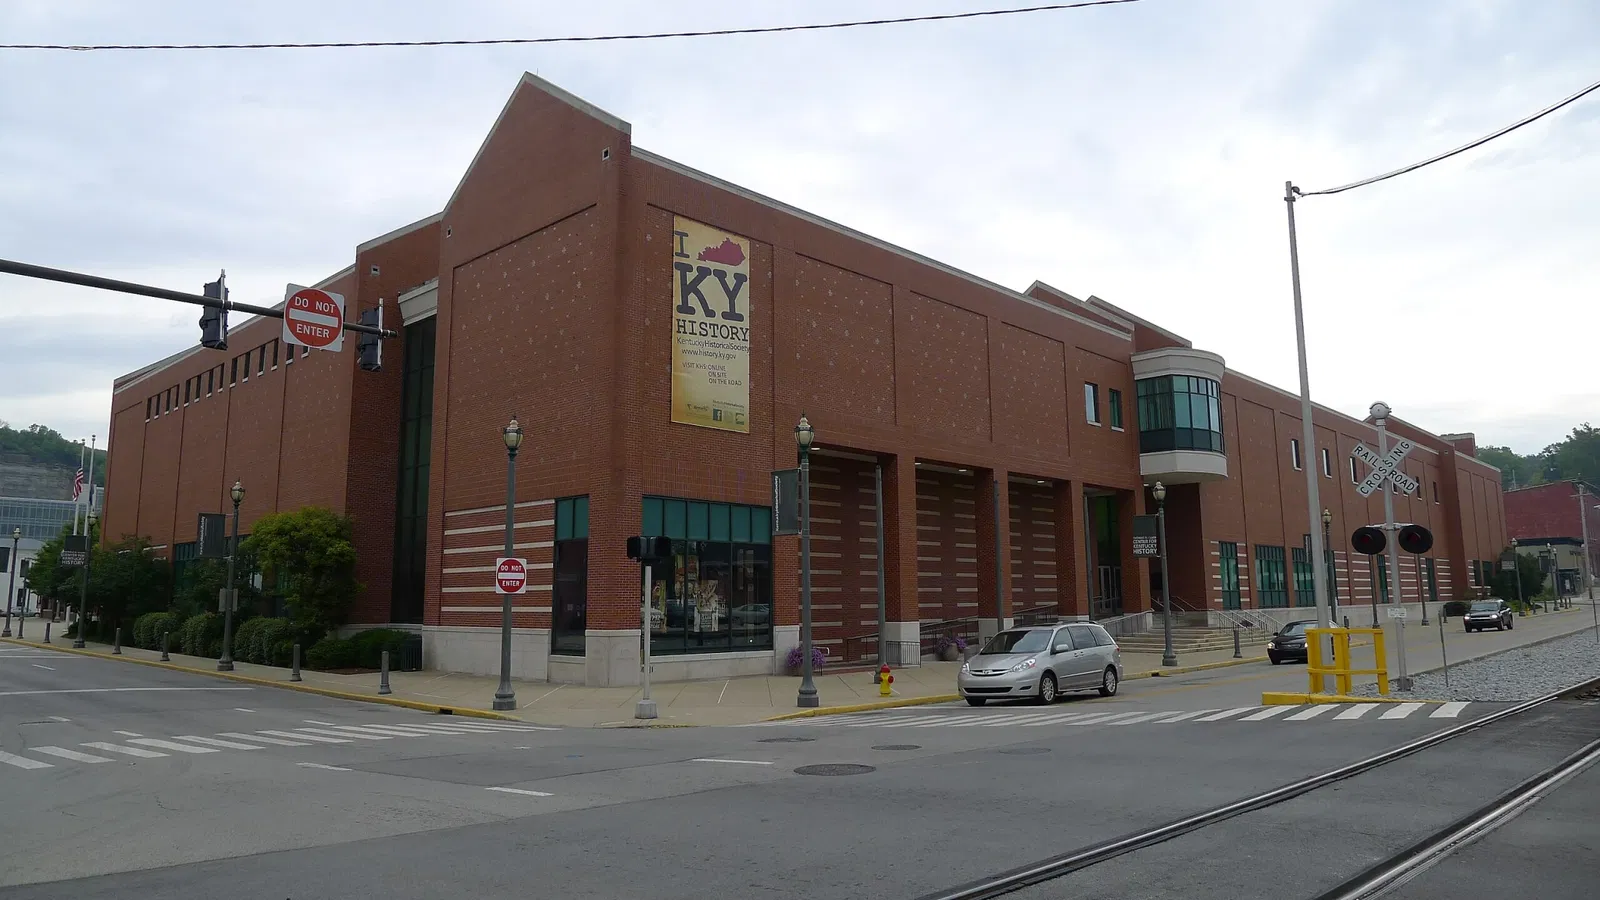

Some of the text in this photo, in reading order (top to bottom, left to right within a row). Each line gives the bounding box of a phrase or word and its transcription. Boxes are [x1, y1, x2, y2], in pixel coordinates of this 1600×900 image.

[674, 230, 690, 259] I
[674, 261, 748, 322] KY
[294, 296, 336, 314] DO NOT
[296, 323, 330, 339] ENTER
[676, 318, 749, 342] HISTORY
[682, 348, 736, 361] www.history.ky.gov
[1360, 441, 1410, 495] CROSSING
